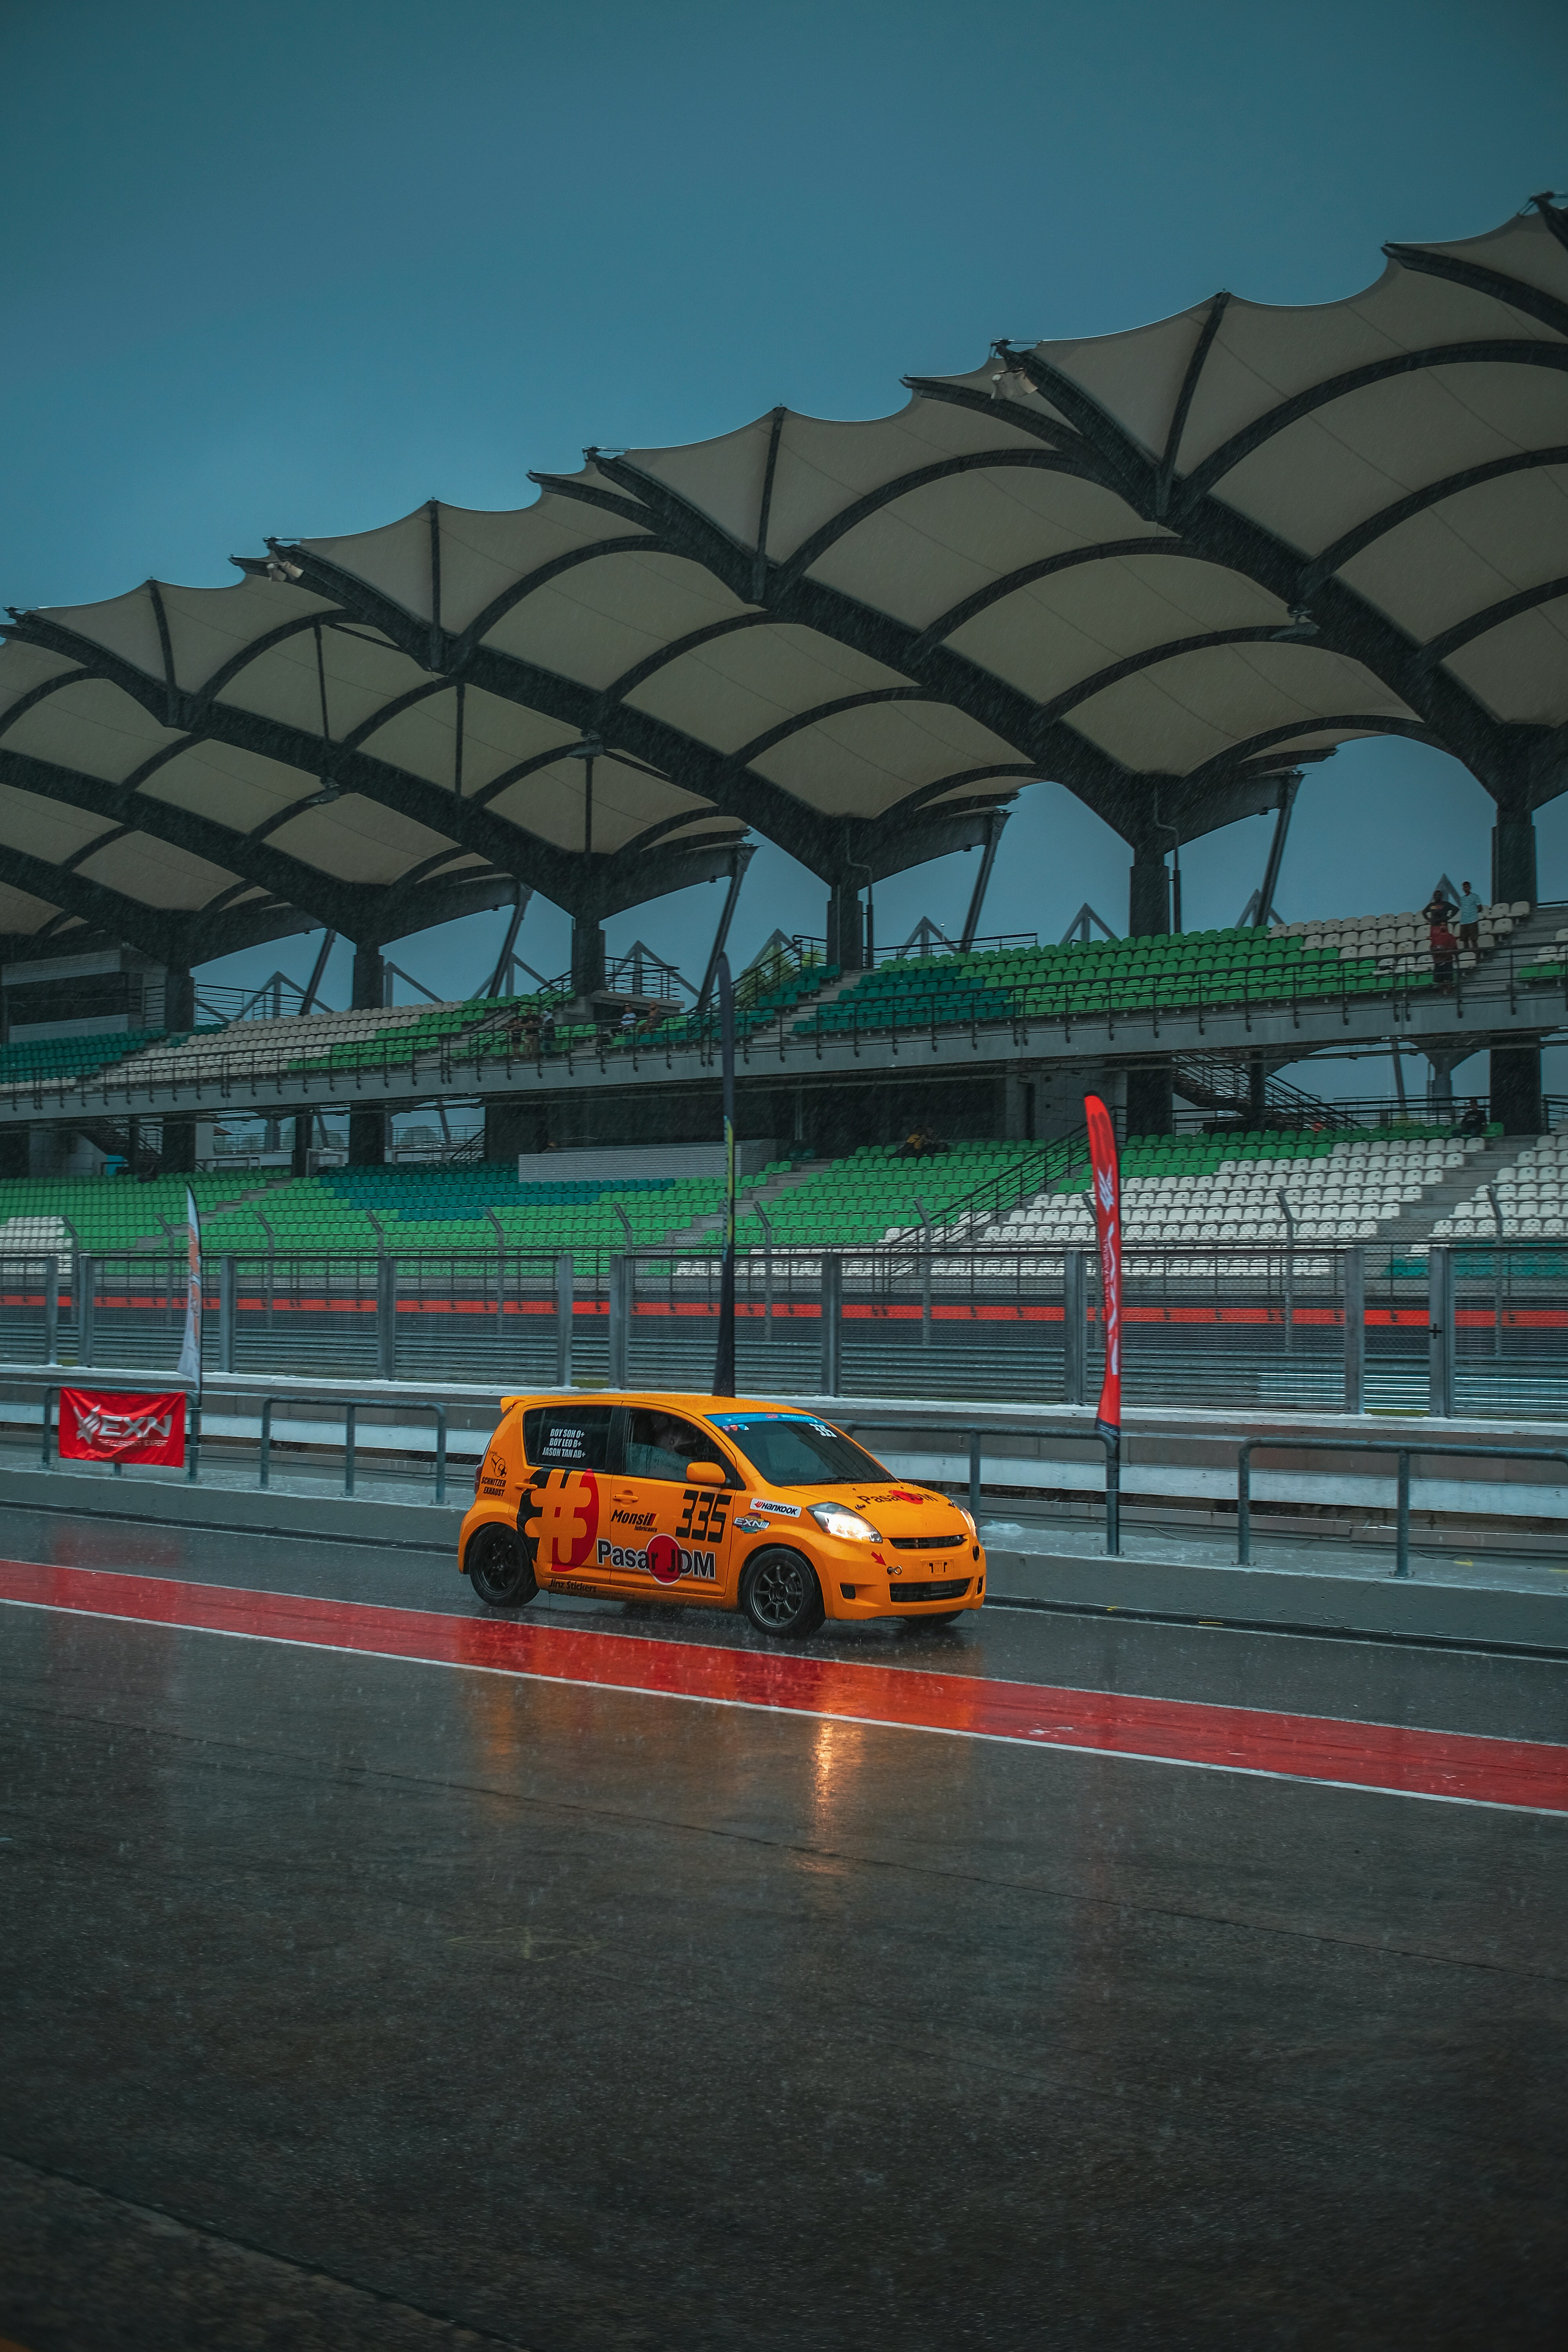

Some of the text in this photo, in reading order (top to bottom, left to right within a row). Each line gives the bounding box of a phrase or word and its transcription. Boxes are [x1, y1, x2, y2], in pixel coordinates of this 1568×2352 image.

[99, 1415, 172, 1438] EXN
[550, 1428, 563, 1437] BOY
[563, 1429, 577, 1438] SOH
[549, 1437, 562, 1446] BOY
[561, 1438, 573, 1447] LEO
[542, 1447, 561, 1457] JASON
[561, 1448, 573, 1458] TAN
[483, 1486, 505, 1497] EXHAUST
[611, 1509, 655, 1526] Monsil
[675, 1489, 732, 1543] 335
[597, 1537, 716, 1580] Pasar JDM
[567, 1581, 597, 1593] Stickers
